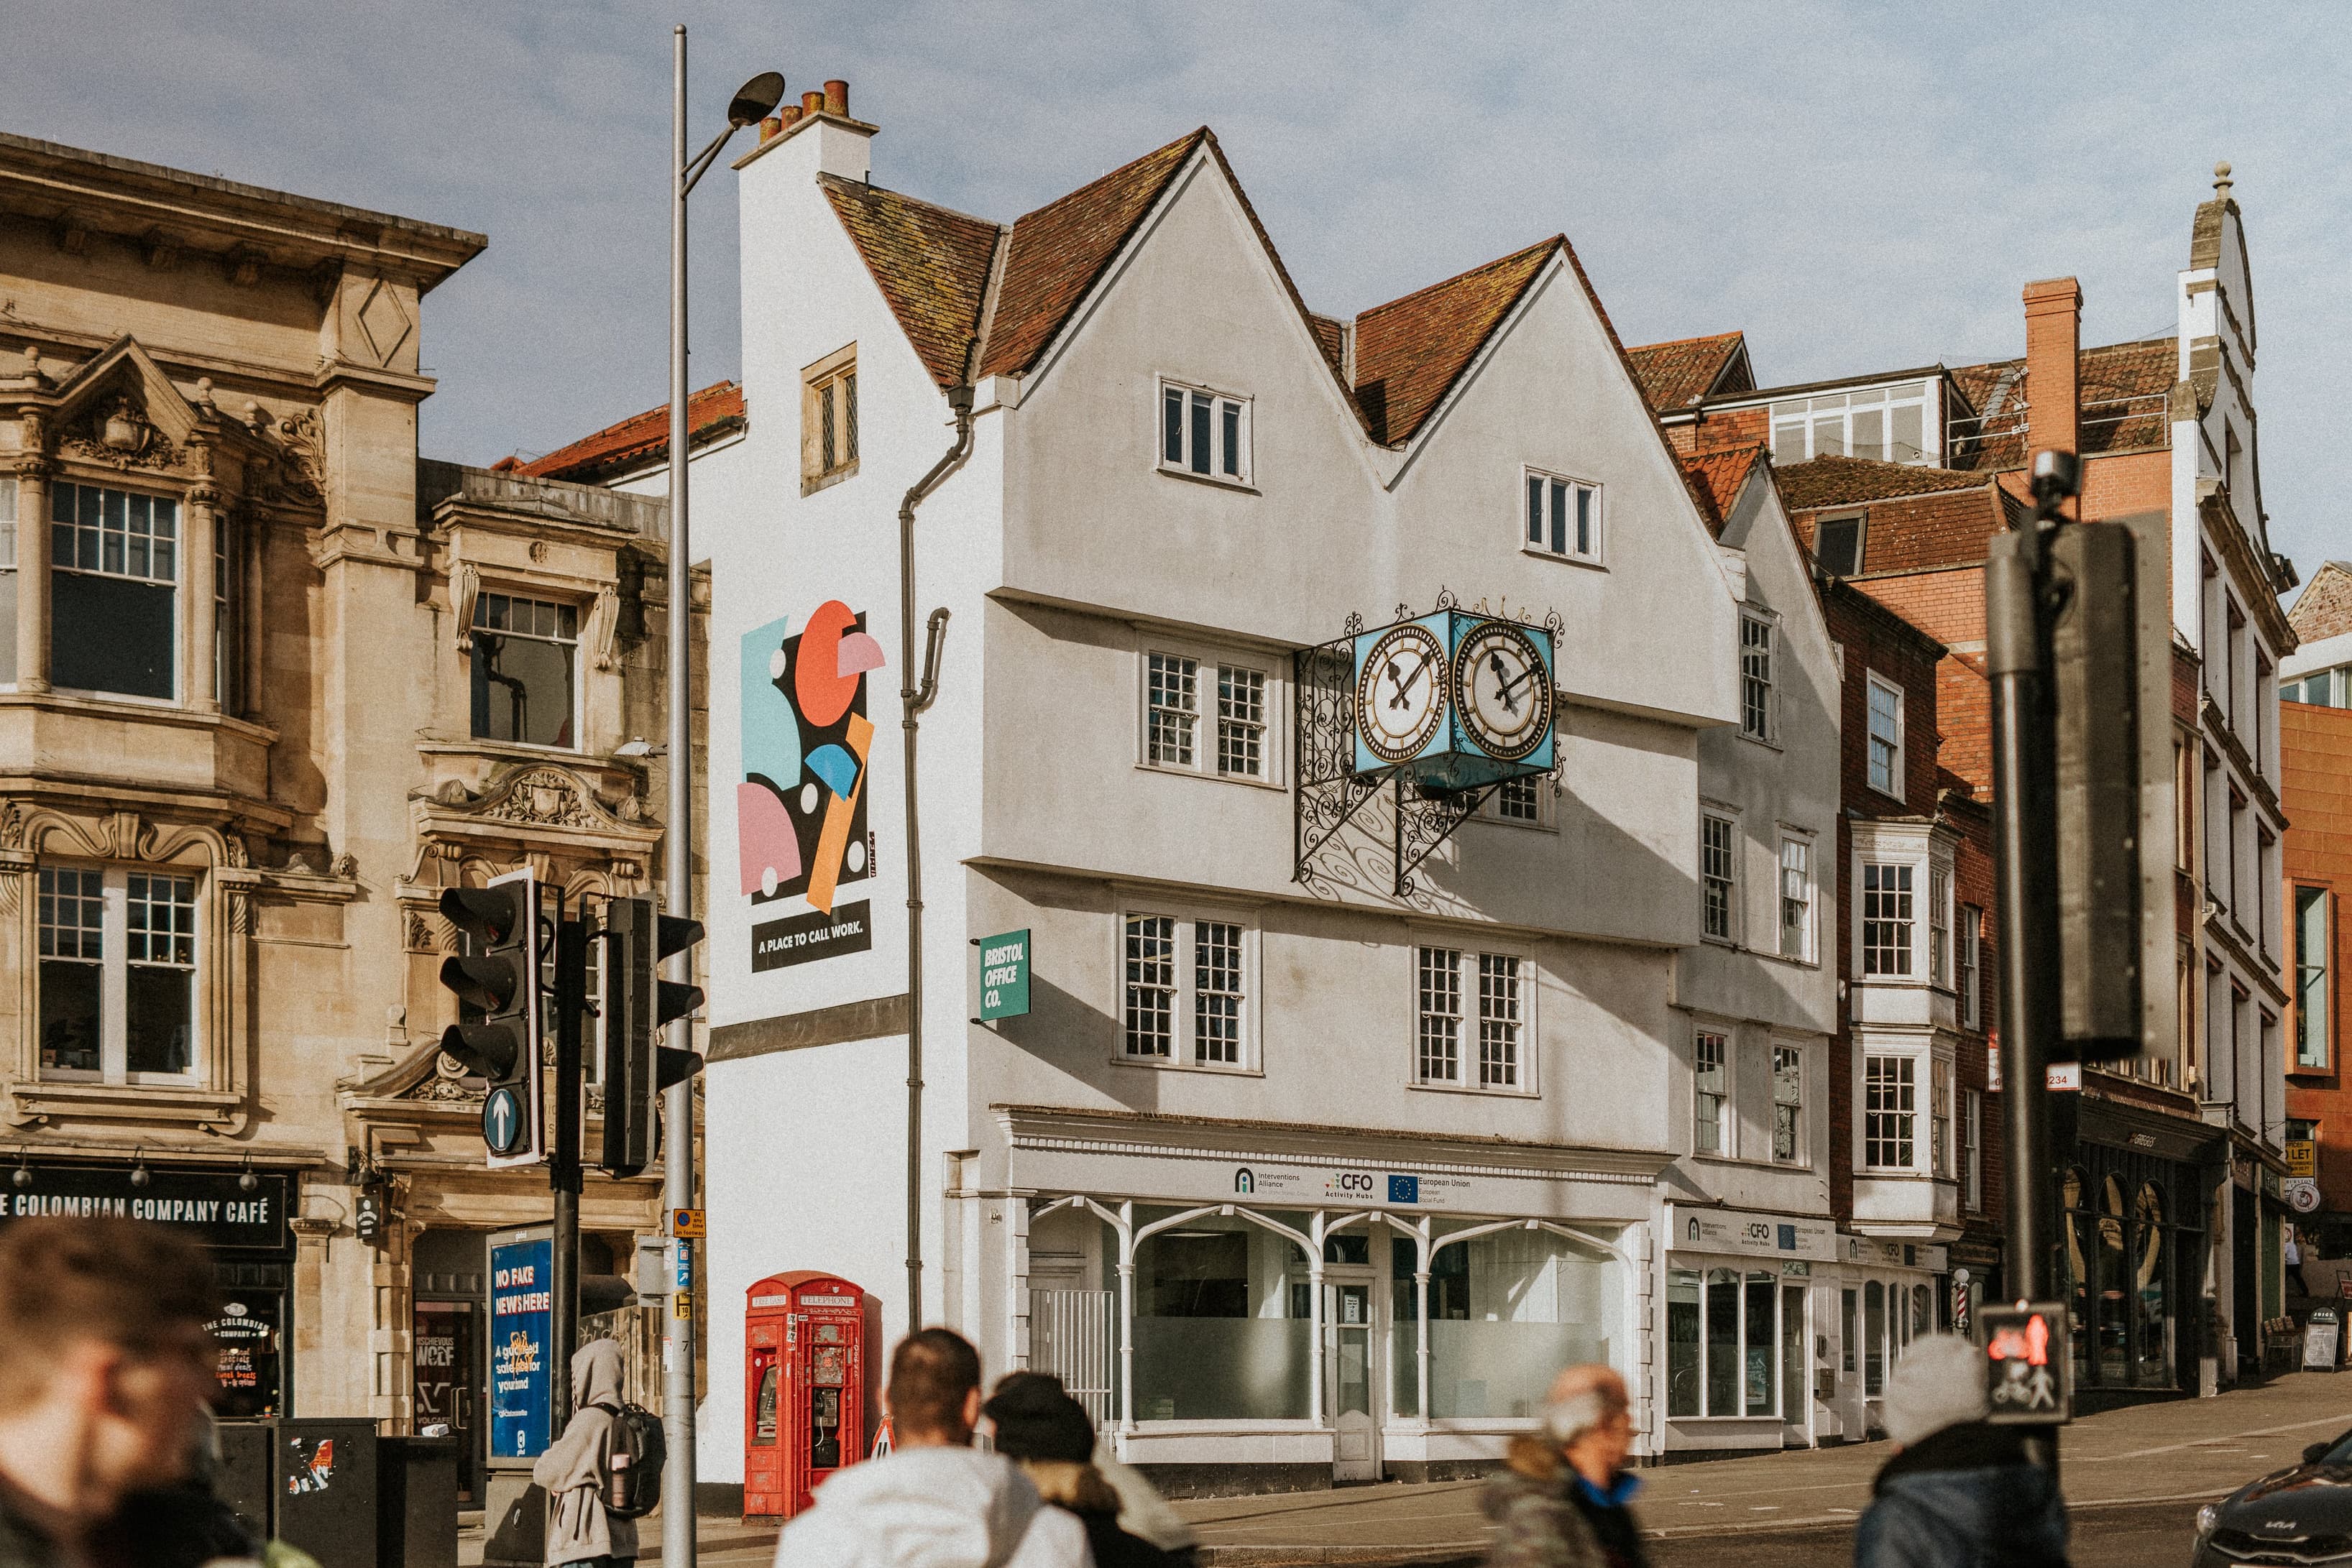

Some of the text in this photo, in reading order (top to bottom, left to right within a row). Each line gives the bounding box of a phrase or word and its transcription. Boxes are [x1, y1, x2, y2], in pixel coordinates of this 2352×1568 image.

[758, 921, 863, 954] A PLACE TO CALL WORK.
[984, 943, 1024, 967] BRISTOL
[985, 965, 1017, 987] OFFICE
[985, 990, 1001, 1008] CO.
[2292, 1149, 2310, 1159] LET
[1341, 1173, 1373, 1191] CFO
[1418, 1177, 1471, 1188] European Union
[1325, 1191, 1353, 1199] Activity
[15, 1194, 126, 1219] COLOMBIAN
[132, 1199, 220, 1222] COMPANY
[226, 1197, 268, 1223] CAFÉ
[1750, 1223, 1769, 1239] CFO
[495, 1265, 534, 1289] NO FAKE
[495, 1292, 549, 1316] NEWS HERE
[770, 1295, 785, 1304] CASH
[802, 1296, 853, 1306] TELEPHONE
[201, 1318, 270, 1331] THE COLOMBIAN
[495, 1345, 502, 1357] A
[682, 1340, 689, 1352] 7
[416, 1346, 454, 1366] WOLF
